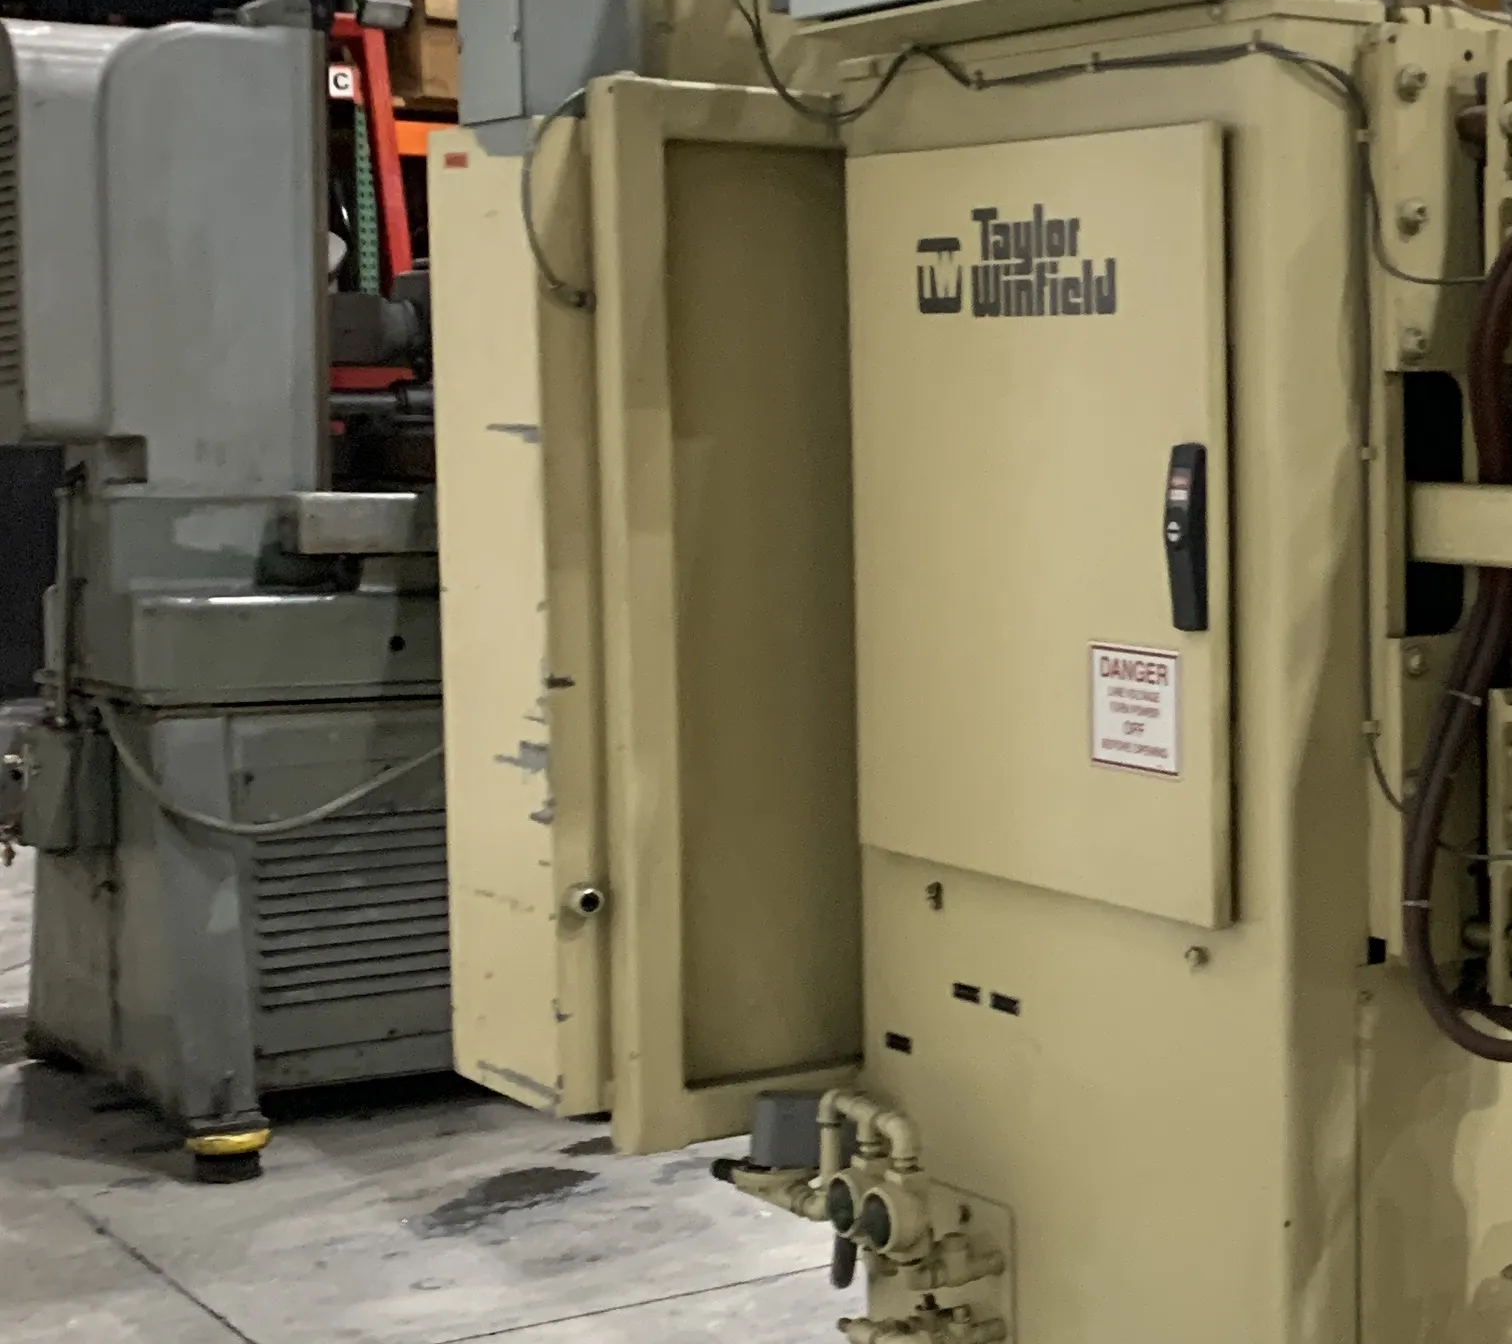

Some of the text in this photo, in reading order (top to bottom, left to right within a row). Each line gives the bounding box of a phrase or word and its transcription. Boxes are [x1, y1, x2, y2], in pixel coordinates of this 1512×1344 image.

[332, 71, 350, 90] C
[971, 203, 1080, 276] Taylor
[970, 256, 1117, 318] Winfield
[1100, 655, 1169, 686] DANGER
